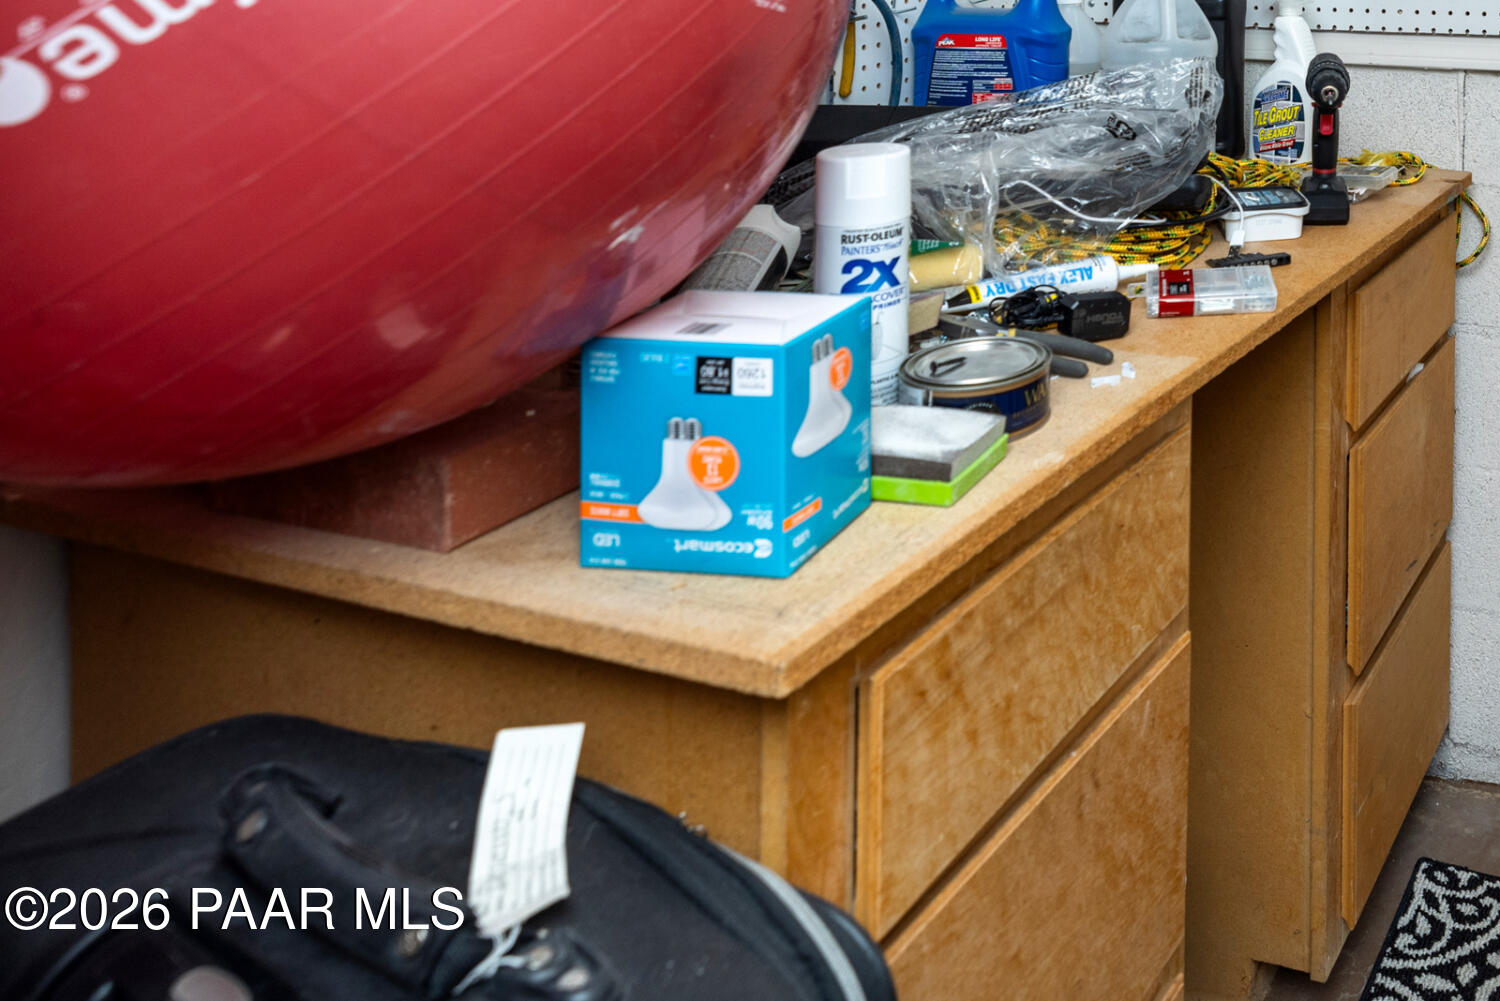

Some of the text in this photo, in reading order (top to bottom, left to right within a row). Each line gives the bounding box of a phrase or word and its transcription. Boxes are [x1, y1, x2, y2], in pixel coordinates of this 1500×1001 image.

[1254, 105, 1300, 126] TILE GROUT
[1258, 124, 1295, 141] CLEANER
[840, 227, 904, 245] RUST-OLEUM
[840, 255, 902, 295] 2X
[1060, 266, 1093, 285] ALEX
[592, 532, 621, 548] LED
[673, 538, 754, 554] ecosmart
